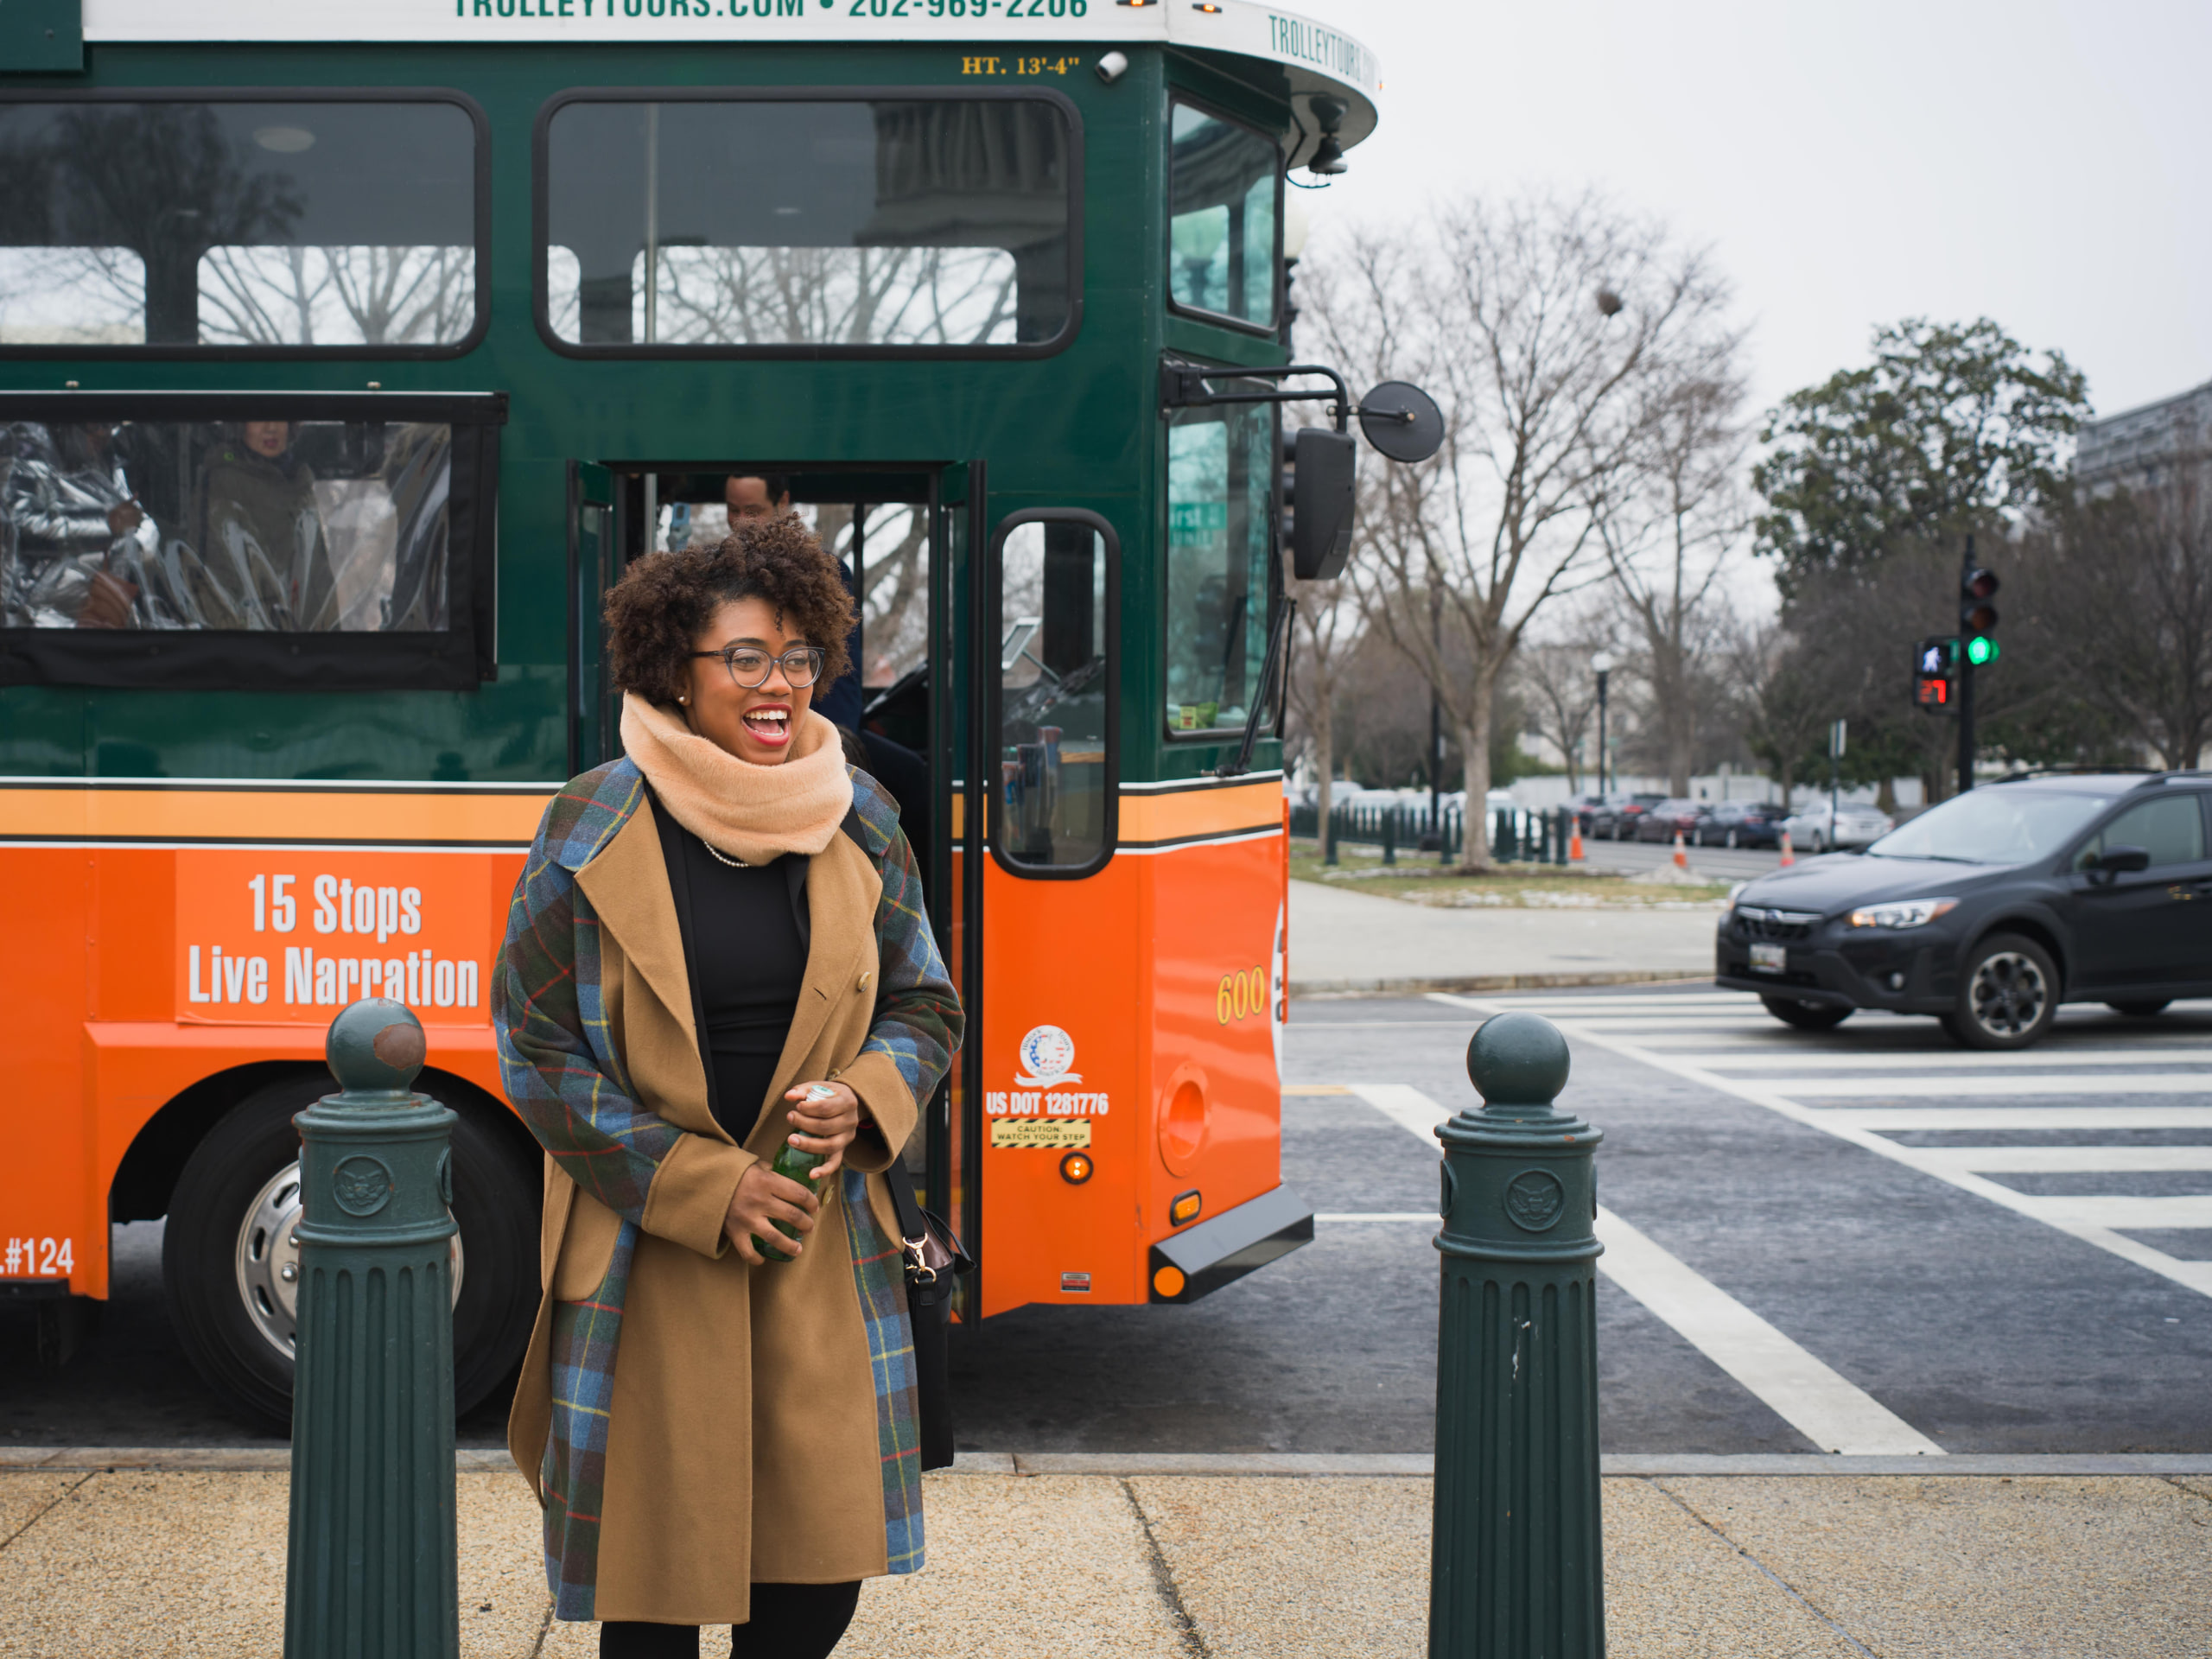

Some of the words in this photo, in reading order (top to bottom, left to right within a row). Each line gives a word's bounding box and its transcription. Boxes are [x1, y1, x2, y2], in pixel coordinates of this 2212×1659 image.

[961, 56, 1007, 75] HT.
[247, 874, 297, 933] 15
[313, 874, 423, 944] Stops
[188, 944, 269, 1004] Live
[284, 948, 480, 1008] Narration
[1216, 964, 1266, 1027] 600
[985, 1091, 1008, 1115] US
[1010, 1091, 1042, 1116] DOT
[1045, 1091, 1109, 1116] 1281776
